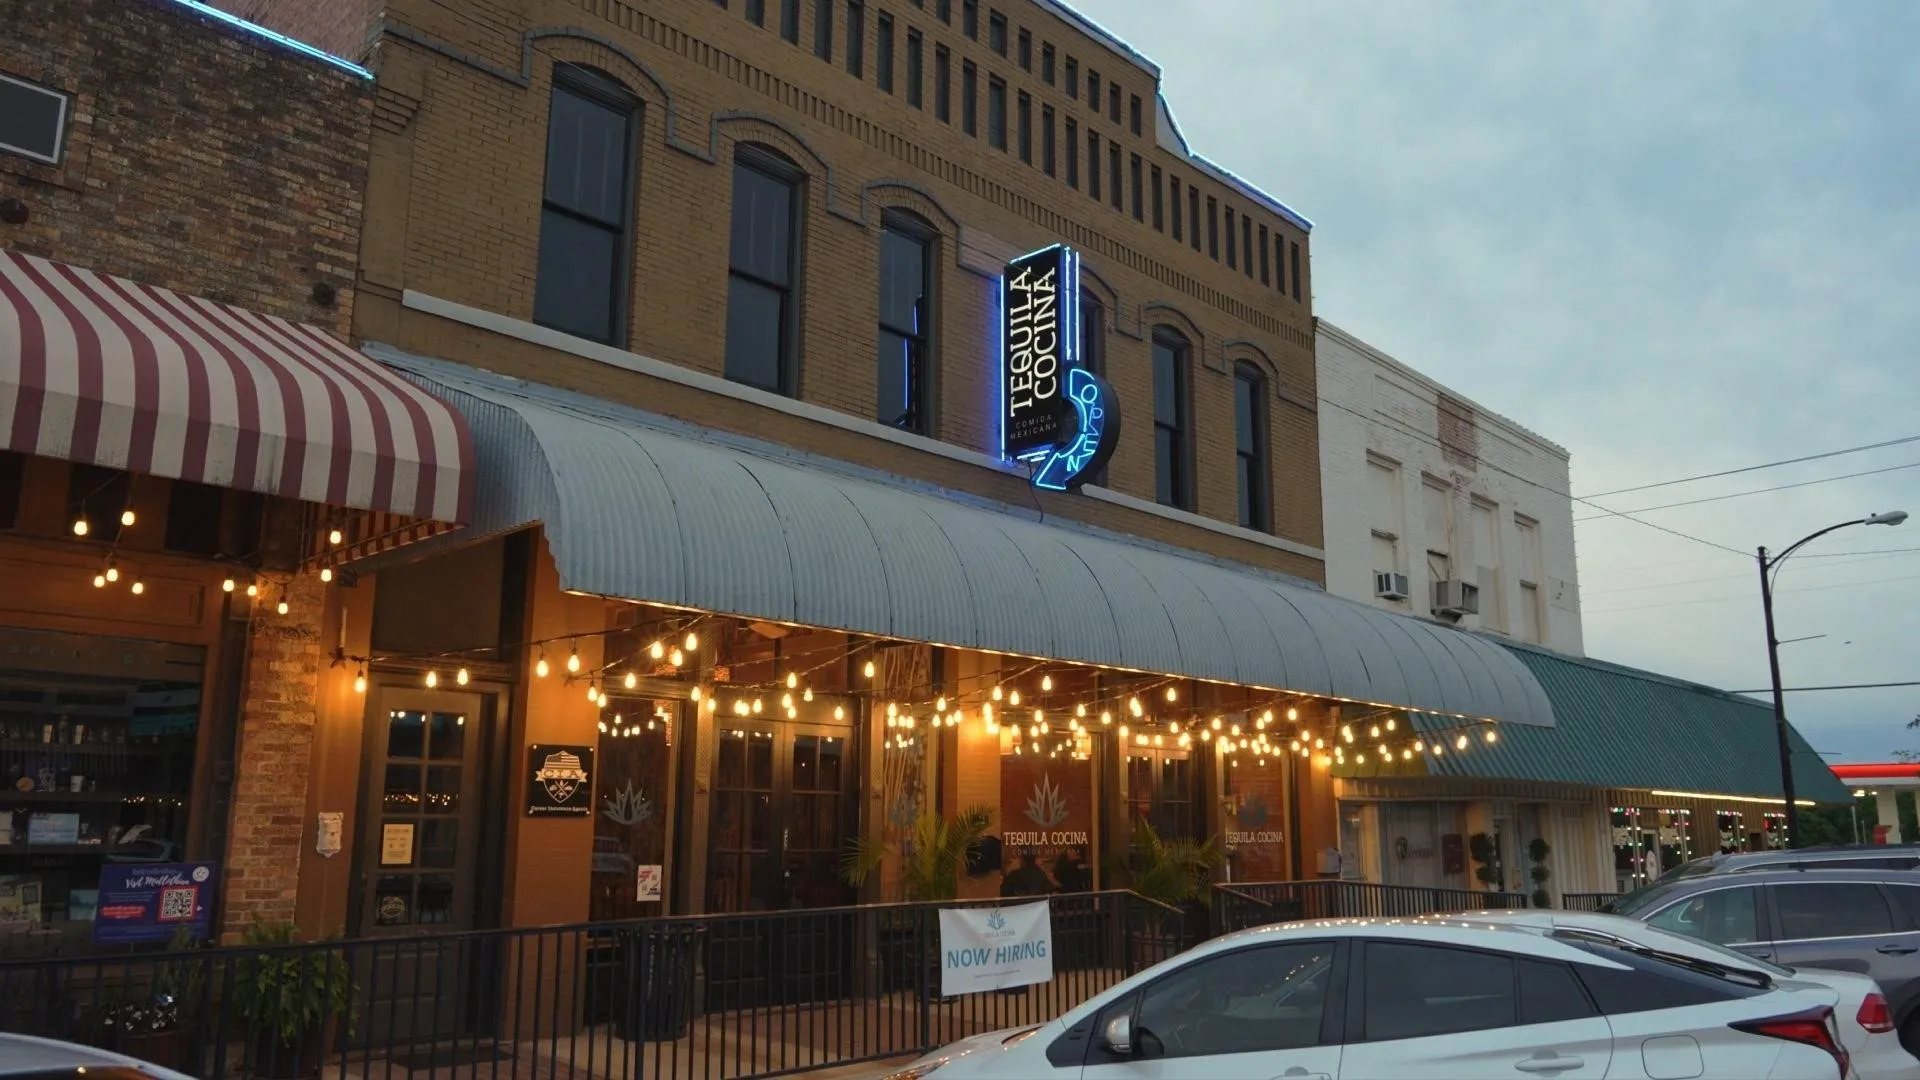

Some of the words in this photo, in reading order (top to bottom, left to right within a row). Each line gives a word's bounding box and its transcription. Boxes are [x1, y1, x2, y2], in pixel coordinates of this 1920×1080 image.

[1010, 266, 1033, 418] TEQUILA
[1034, 267, 1057, 400] COCINA
[1010, 422, 1057, 440] MEXICANA
[1015, 414, 1053, 430] COMIDA
[1066, 383, 1104, 472] OPEN
[543, 769, 580, 779] CIA
[1004, 832, 1048, 846] TEQUILA
[1051, 831, 1088, 845] COCINA
[1225, 831, 1256, 843] TEQUILA
[1257, 831, 1284, 843] COCINA
[947, 947, 991, 969] NOW
[995, 940, 1046, 965] HIRING
